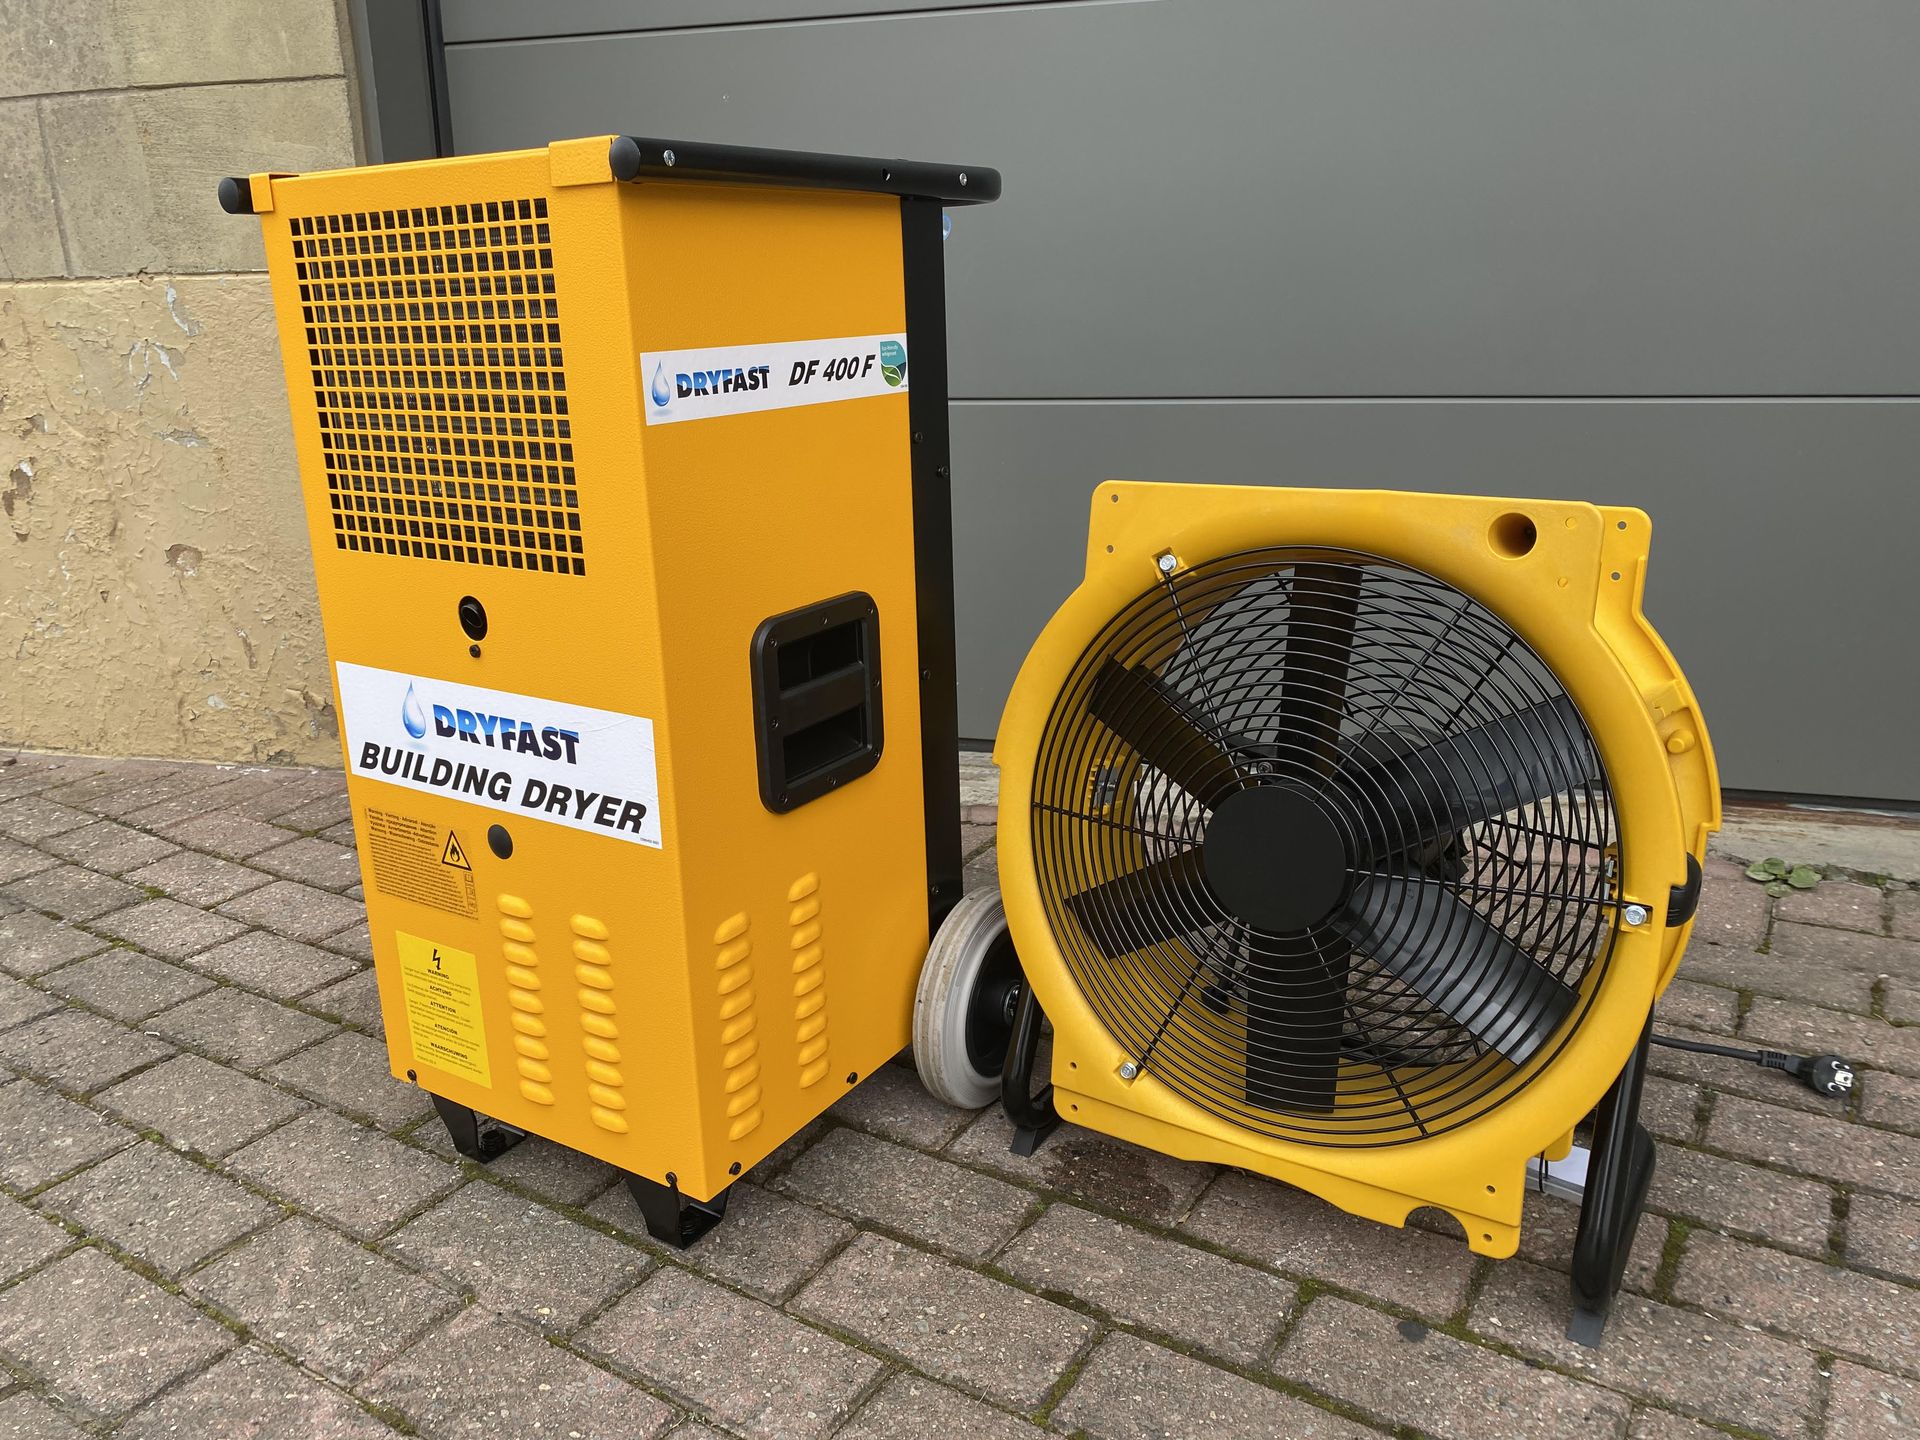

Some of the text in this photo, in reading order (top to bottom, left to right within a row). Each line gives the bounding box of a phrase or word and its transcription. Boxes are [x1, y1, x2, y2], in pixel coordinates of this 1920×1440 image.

[676, 354, 876, 398] DRYFAST DF 400 F
[433, 705, 580, 765] DRYFAST
[359, 742, 647, 834] BUILDING DRYER
[427, 969, 449, 980] WARNING
[429, 985, 452, 996] ACHTUNG
[430, 1001, 457, 1014] ATTENTION
[430, 1042, 468, 1060] WAARSCHUWING
